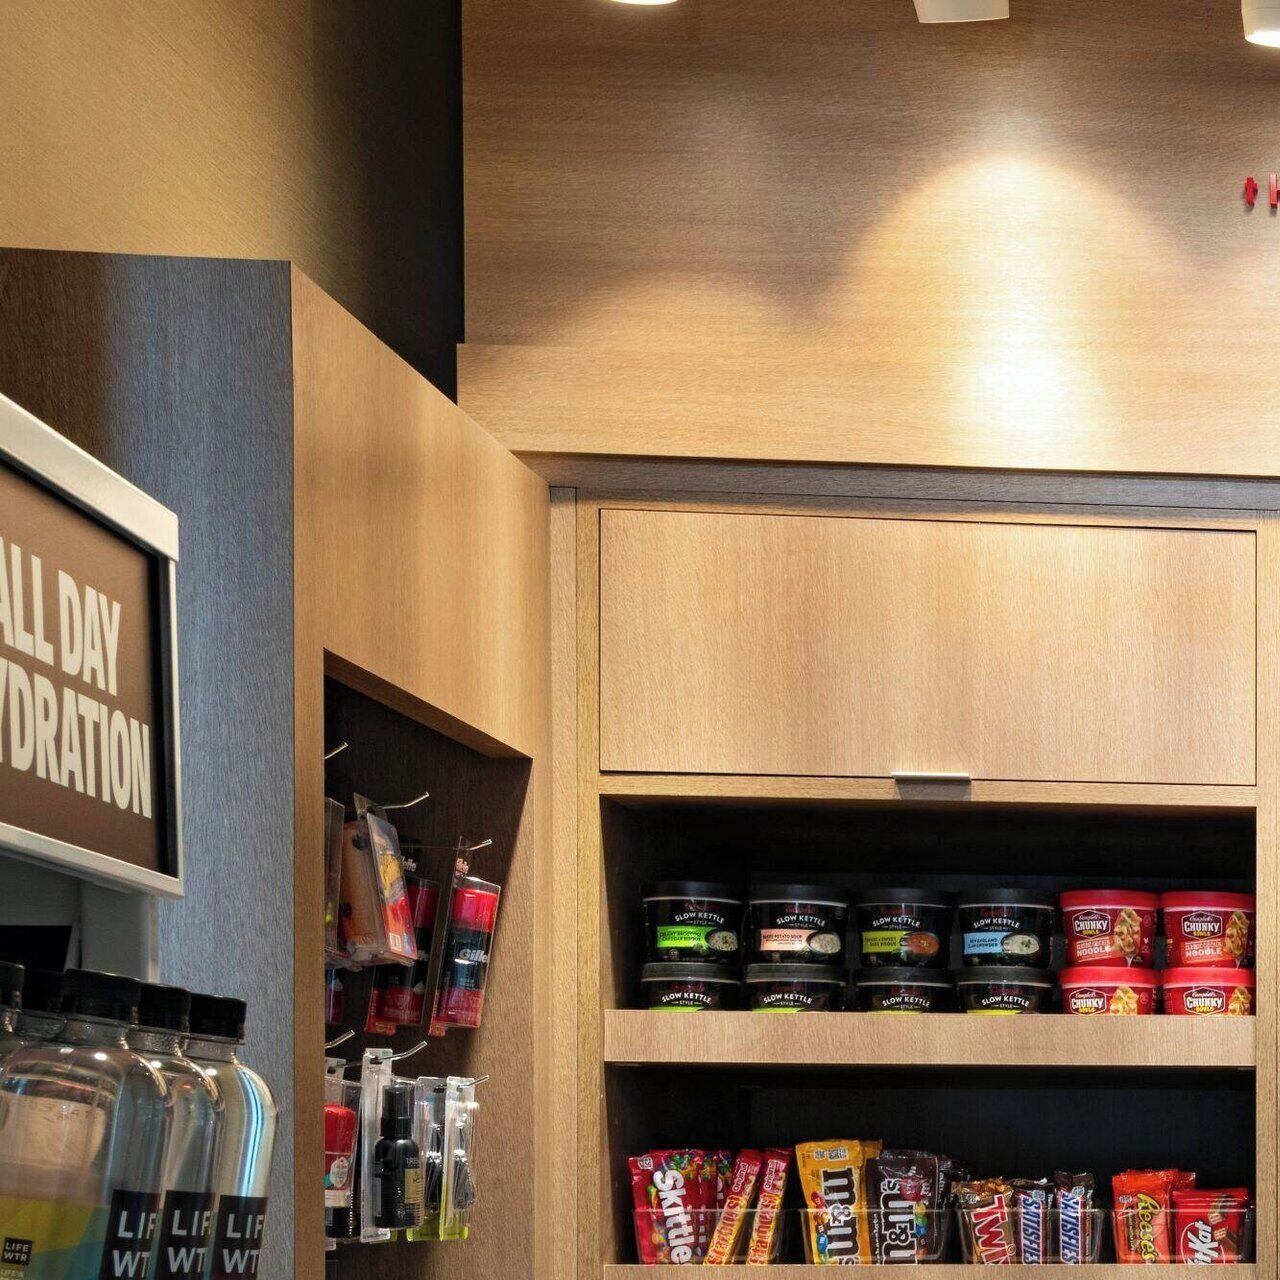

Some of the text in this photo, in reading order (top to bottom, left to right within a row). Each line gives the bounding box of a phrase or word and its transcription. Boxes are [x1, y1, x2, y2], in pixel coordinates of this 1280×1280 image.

[58, 569, 122, 697] DAY
[674, 911, 725, 924] SLOW KETTLE
[776, 914, 826, 927] SLOW KETTLE
[872, 917, 921, 928] SLOW KETTLE
[973, 918, 1021, 929] SLOW KETTLE
[1073, 919, 1108, 932] CHUNKY
[1183, 921, 1219, 933] CHUNKY
[1076, 945, 1112, 957] NOODLE
[1185, 947, 1222, 957] NOODLE
[683, 992, 711, 1004] KETTLE
[785, 993, 812, 1005] KETTLE
[1071, 997, 1104, 1009] CHUNKY
[1186, 997, 1223, 1009] CHUNKY
[652, 1169, 695, 1264] Skittle
[118, 1210, 156, 1239] LIF
[172, 1210, 212, 1237] LIF
[226, 1213, 265, 1239] LIF
[971, 1194, 1010, 1264] TWI
[1137, 1193, 1161, 1263] Reese's
[5, 1241, 29, 1253] LIFE
[4, 1251, 28, 1262] WTR
[167, 1246, 207, 1274] WT
[223, 1248, 259, 1274] WT
[112, 1250, 150, 1278] WT
